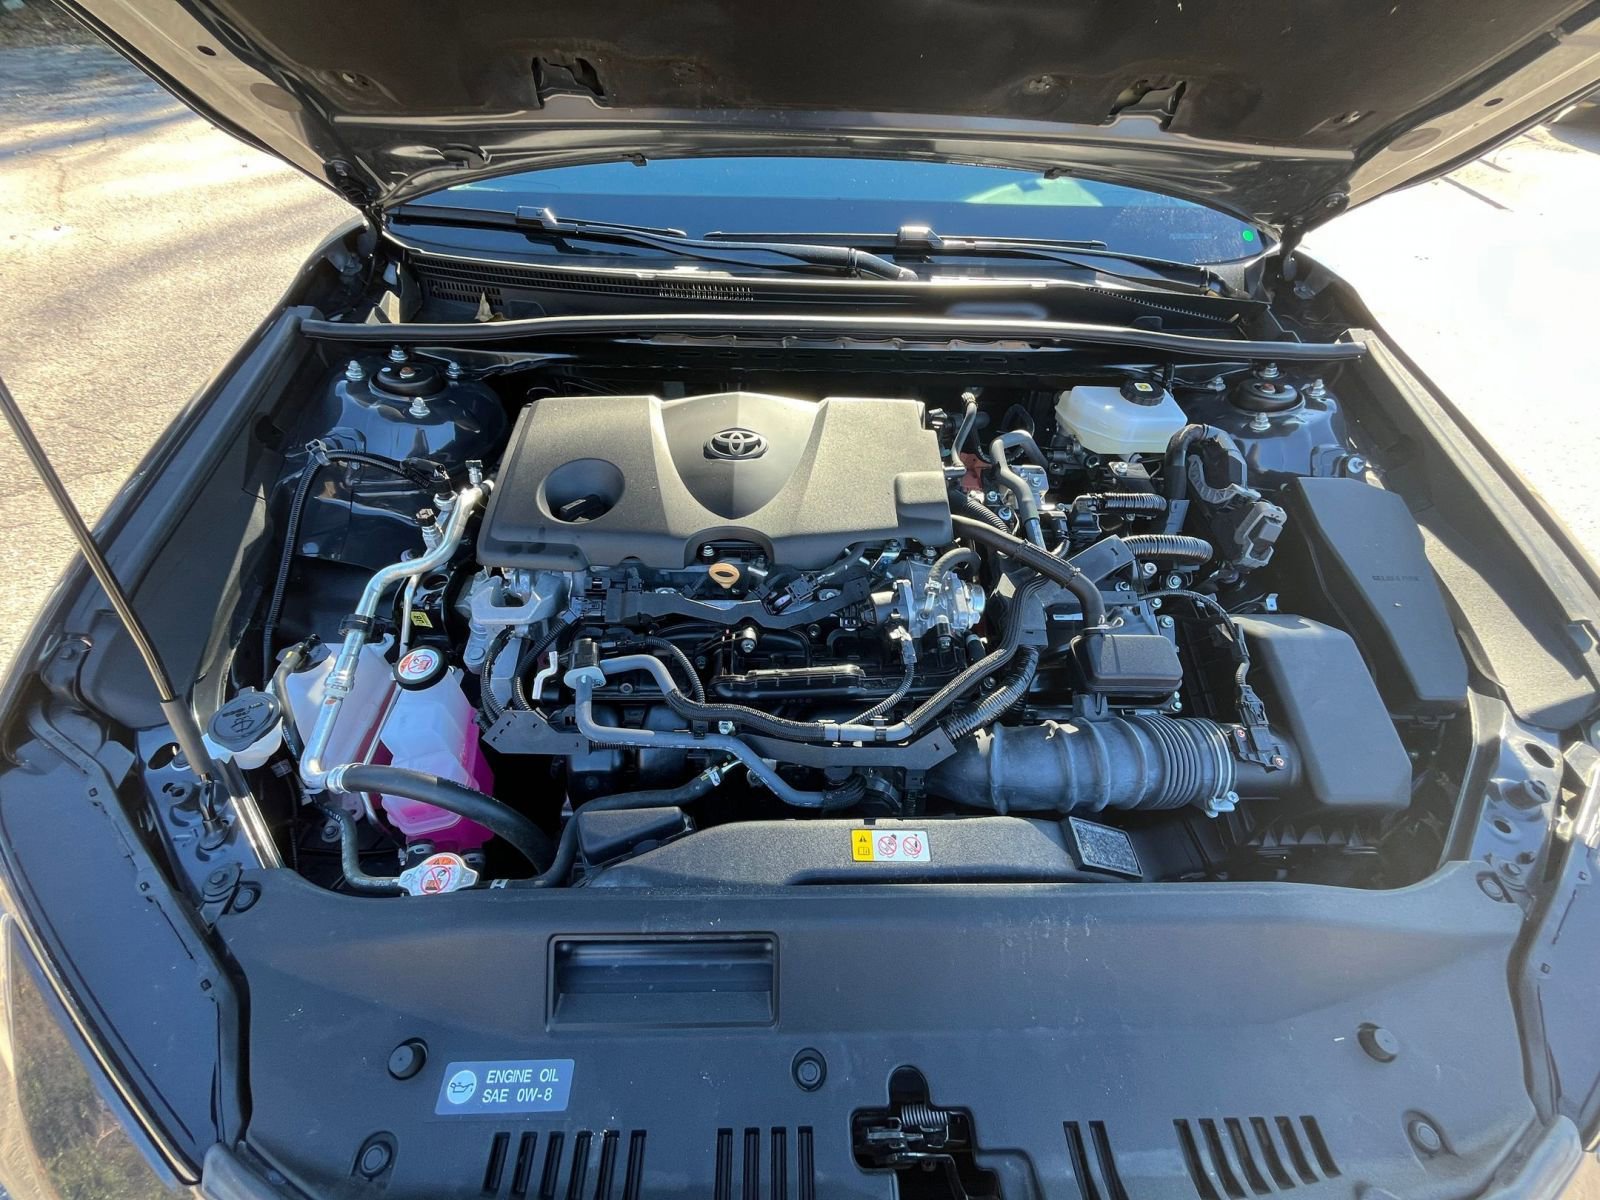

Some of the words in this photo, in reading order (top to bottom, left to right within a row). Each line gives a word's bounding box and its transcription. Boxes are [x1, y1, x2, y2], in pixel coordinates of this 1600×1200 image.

[486, 1069, 533, 1084] ENGINE
[539, 1068, 559, 1083] OIL
[482, 1088, 509, 1103] SAE
[516, 1087, 553, 1102] 0W-8
